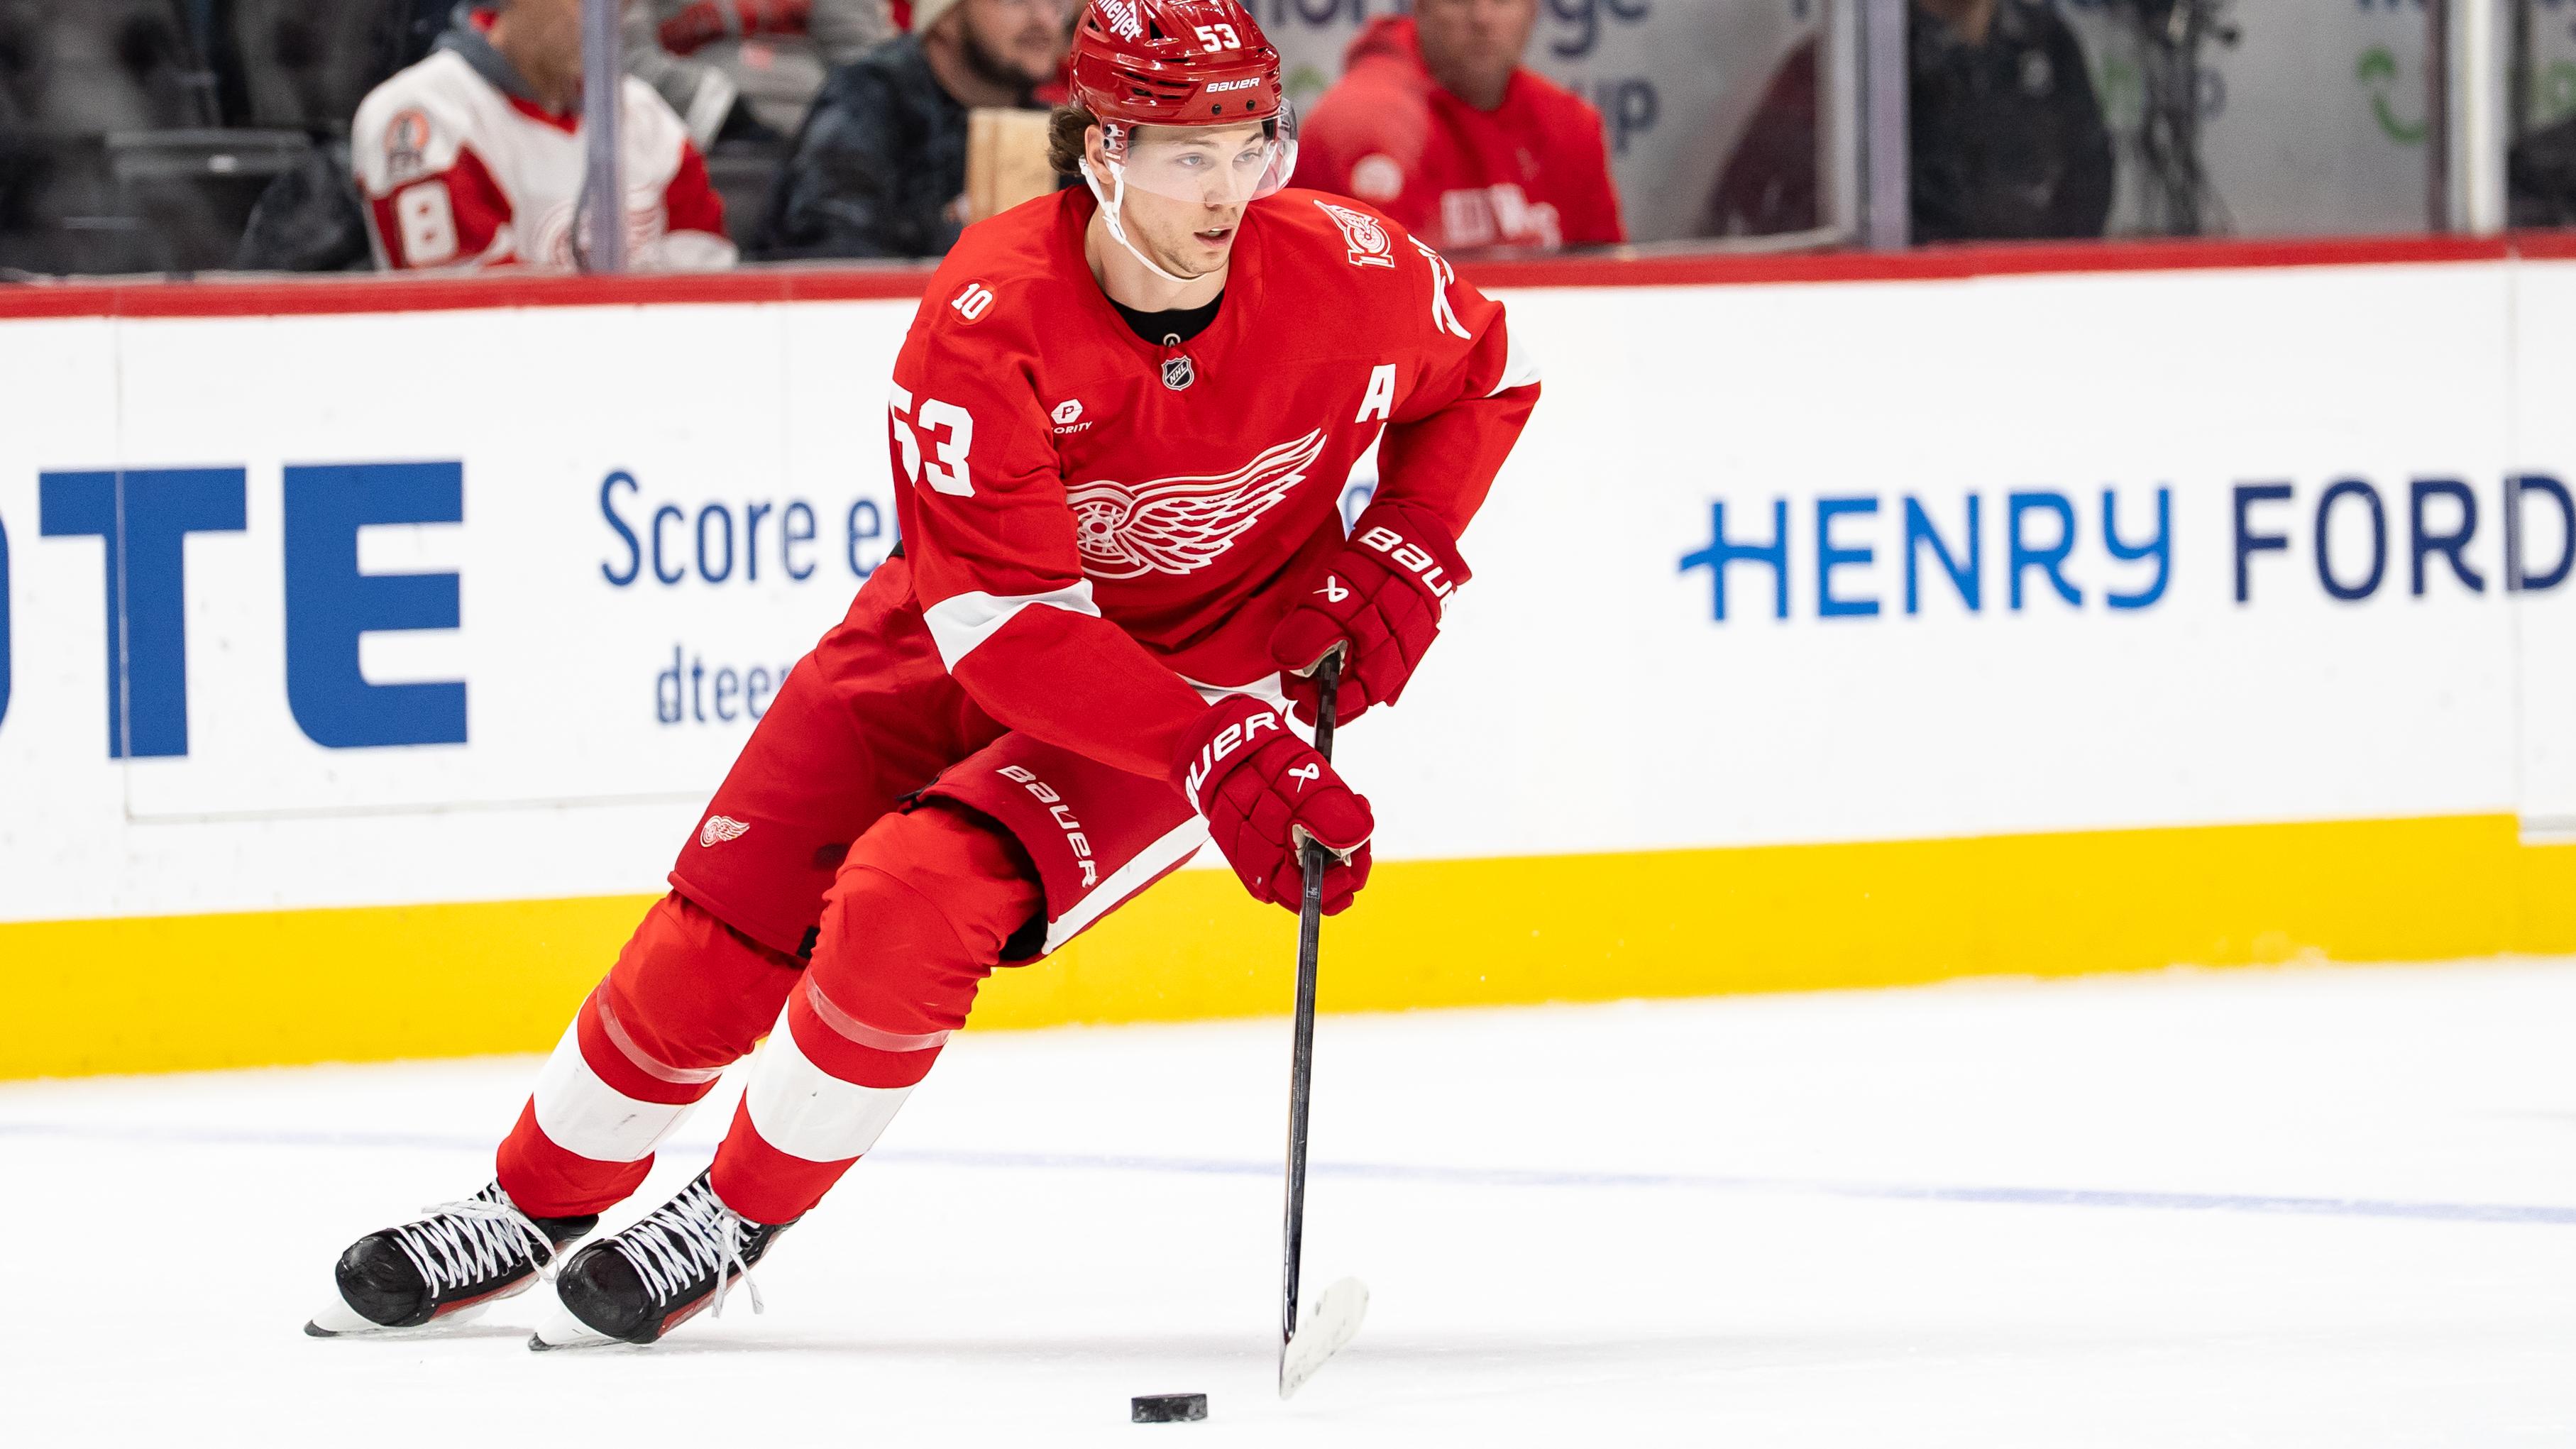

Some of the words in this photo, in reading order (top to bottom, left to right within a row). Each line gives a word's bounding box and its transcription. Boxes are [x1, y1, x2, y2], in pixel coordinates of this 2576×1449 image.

[1194, 23, 1240, 53] 53
[951, 283, 993, 320] 10
[1169, 364, 1187, 384] NHL
[1355, 363, 1396, 423] A
[889, 380, 976, 497] 53
[1051, 421, 1093, 434] ORITY
[601, 470, 815, 586] Score
[1679, 486, 2171, 622] HENRY
[2233, 477, 2576, 602] FORD
[0, 462, 467, 758] TE
[657, 645, 791, 723] dtee
